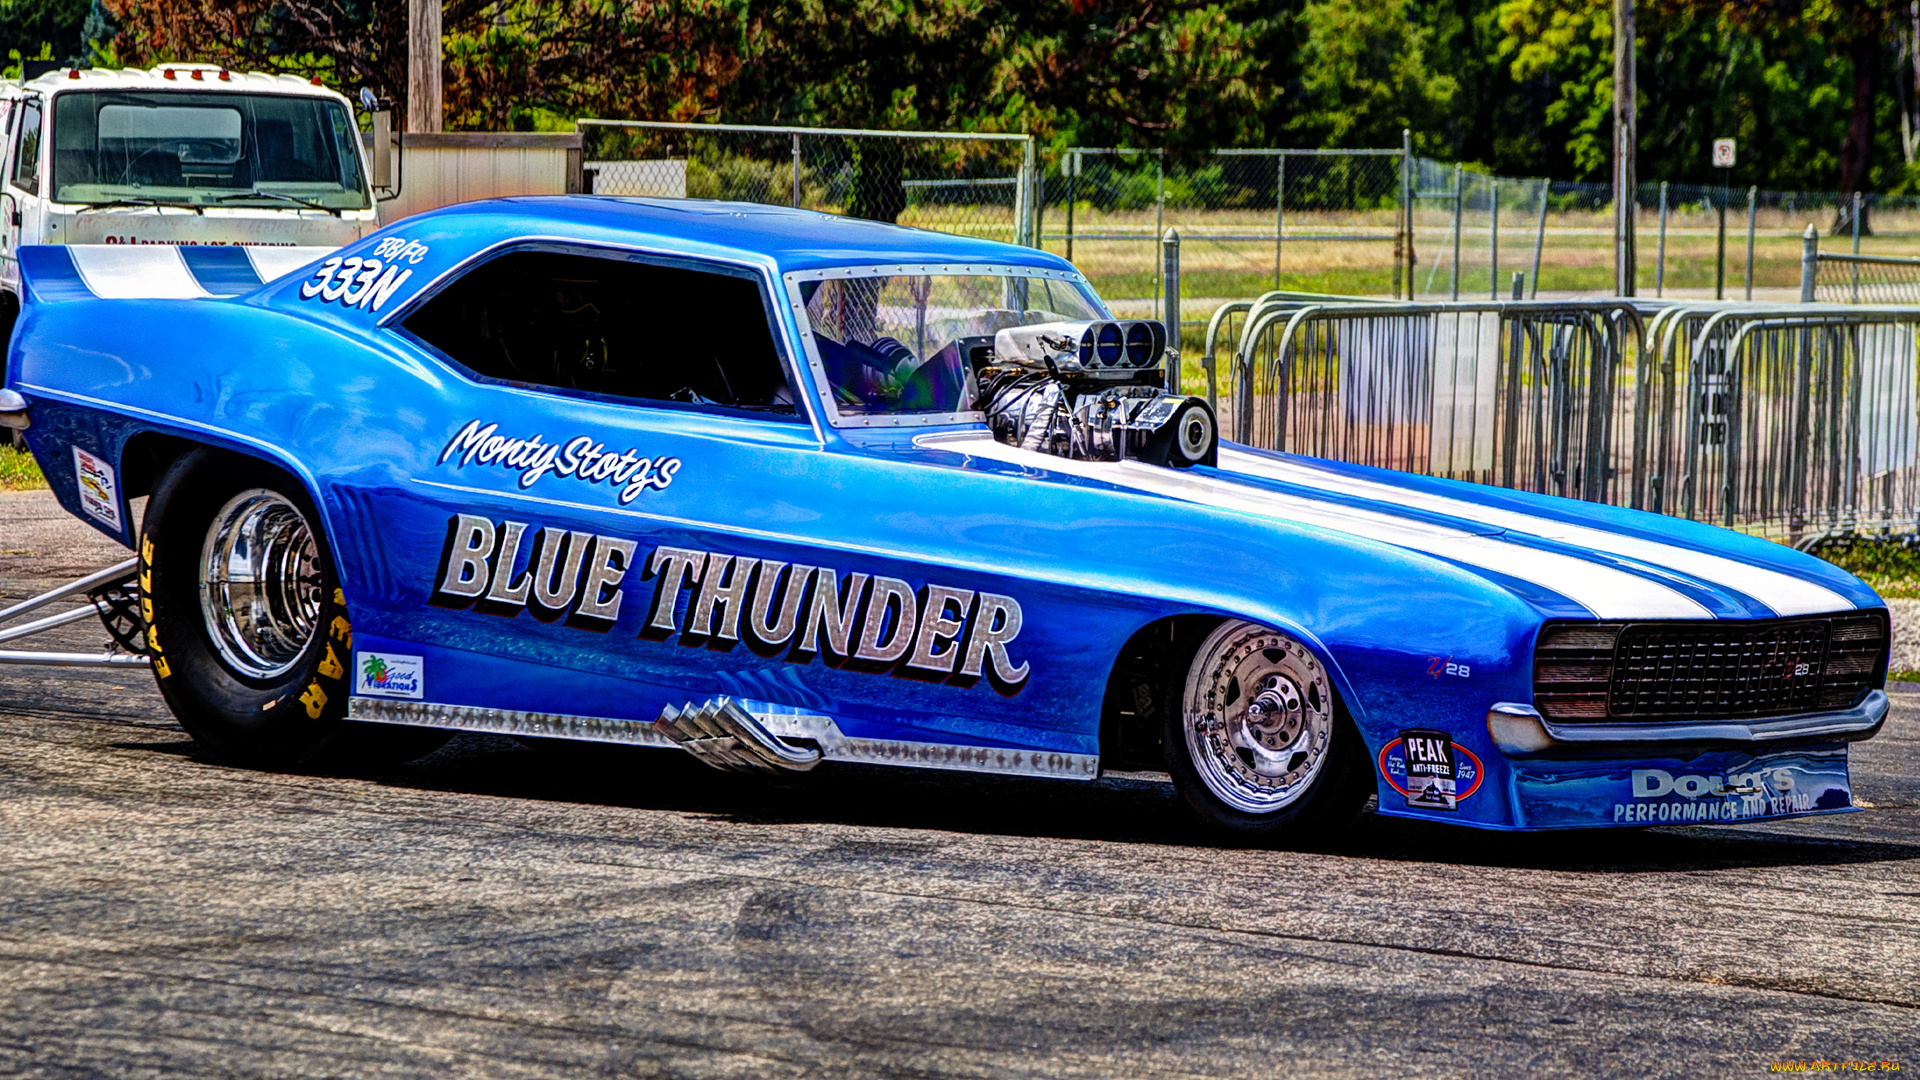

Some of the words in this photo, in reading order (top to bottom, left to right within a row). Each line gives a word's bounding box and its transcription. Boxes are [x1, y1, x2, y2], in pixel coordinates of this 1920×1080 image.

[373, 236, 429, 265] BB/FC
[299, 256, 413, 313] 333N
[437, 419, 560, 489] Monty
[436, 512, 638, 627] BLUE
[646, 545, 1031, 692] THUNDER
[1408, 738, 1448, 763] PEAK
[1412, 763, 1450, 775] ANTI-FREEZE
[1456, 769, 1476, 779] 1947
[1631, 767, 1796, 801] Doug's
[1613, 802, 1738, 823] PERFORMANCE
[1742, 798, 1767, 818] AND
[1771, 793, 1811, 815] REPAIR
